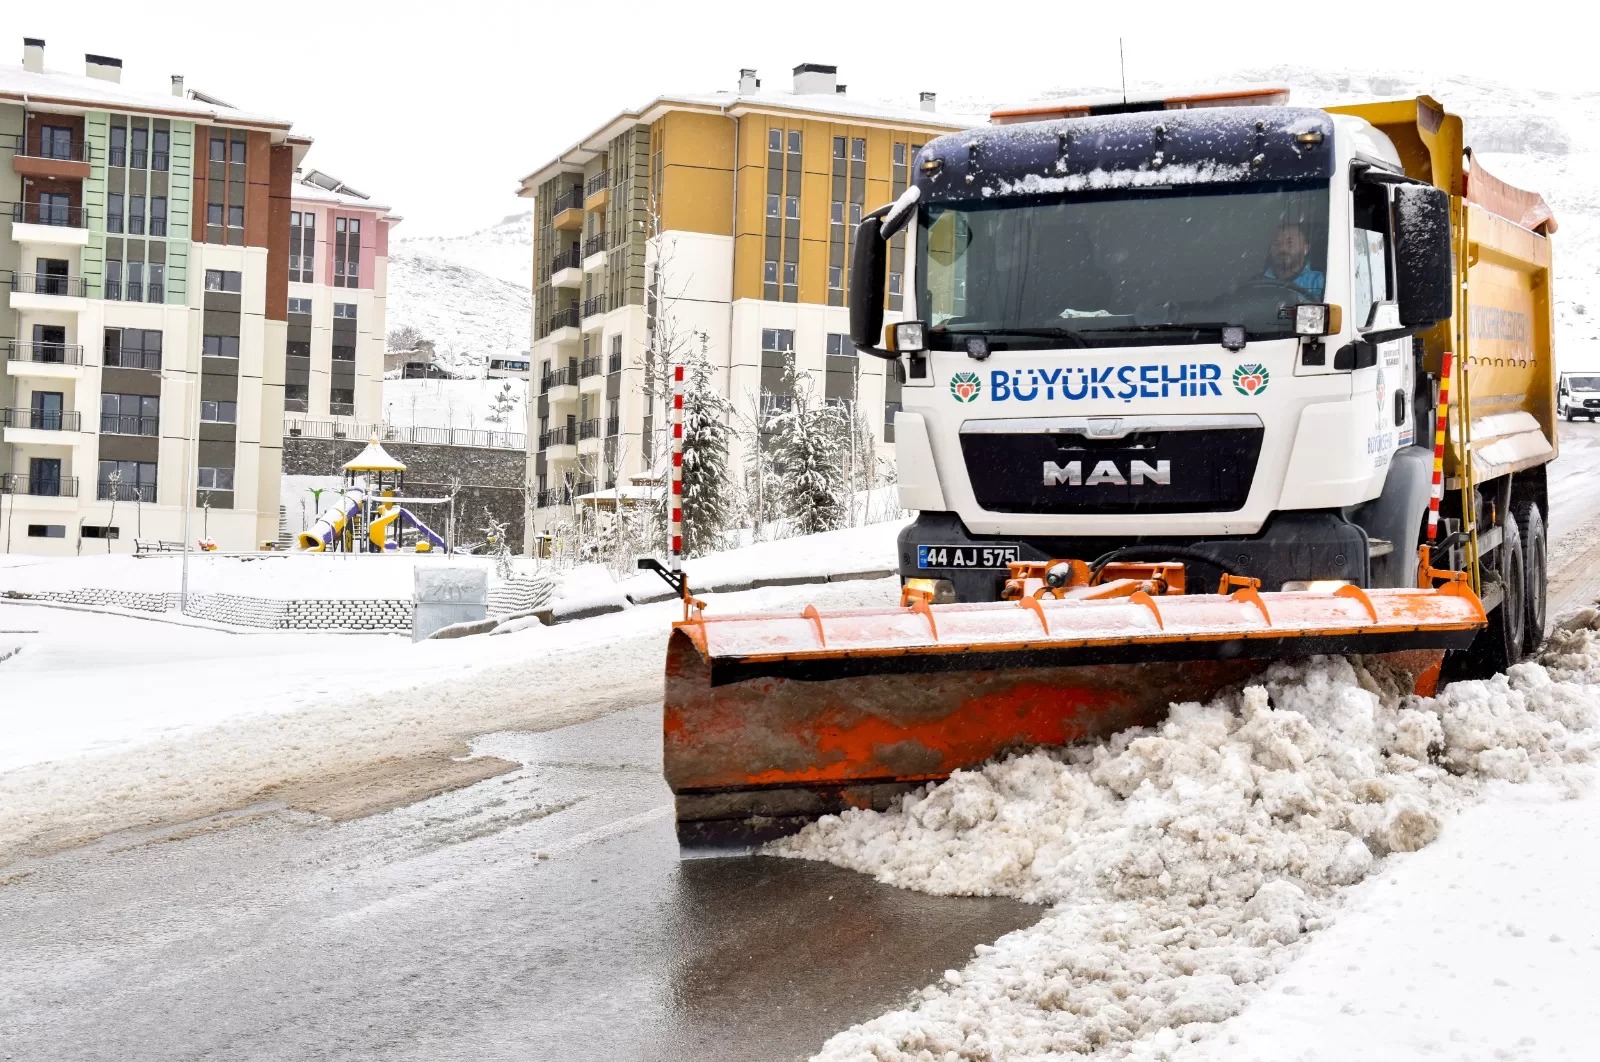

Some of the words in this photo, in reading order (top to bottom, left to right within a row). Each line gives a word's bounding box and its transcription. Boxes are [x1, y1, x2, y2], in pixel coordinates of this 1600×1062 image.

[991, 363, 1222, 402] BÜYÜKŞEHİR
[1043, 460, 1171, 486] MAN
[927, 548, 948, 566] 44
[952, 548, 978, 566] AJ
[982, 548, 1016, 567] 575
